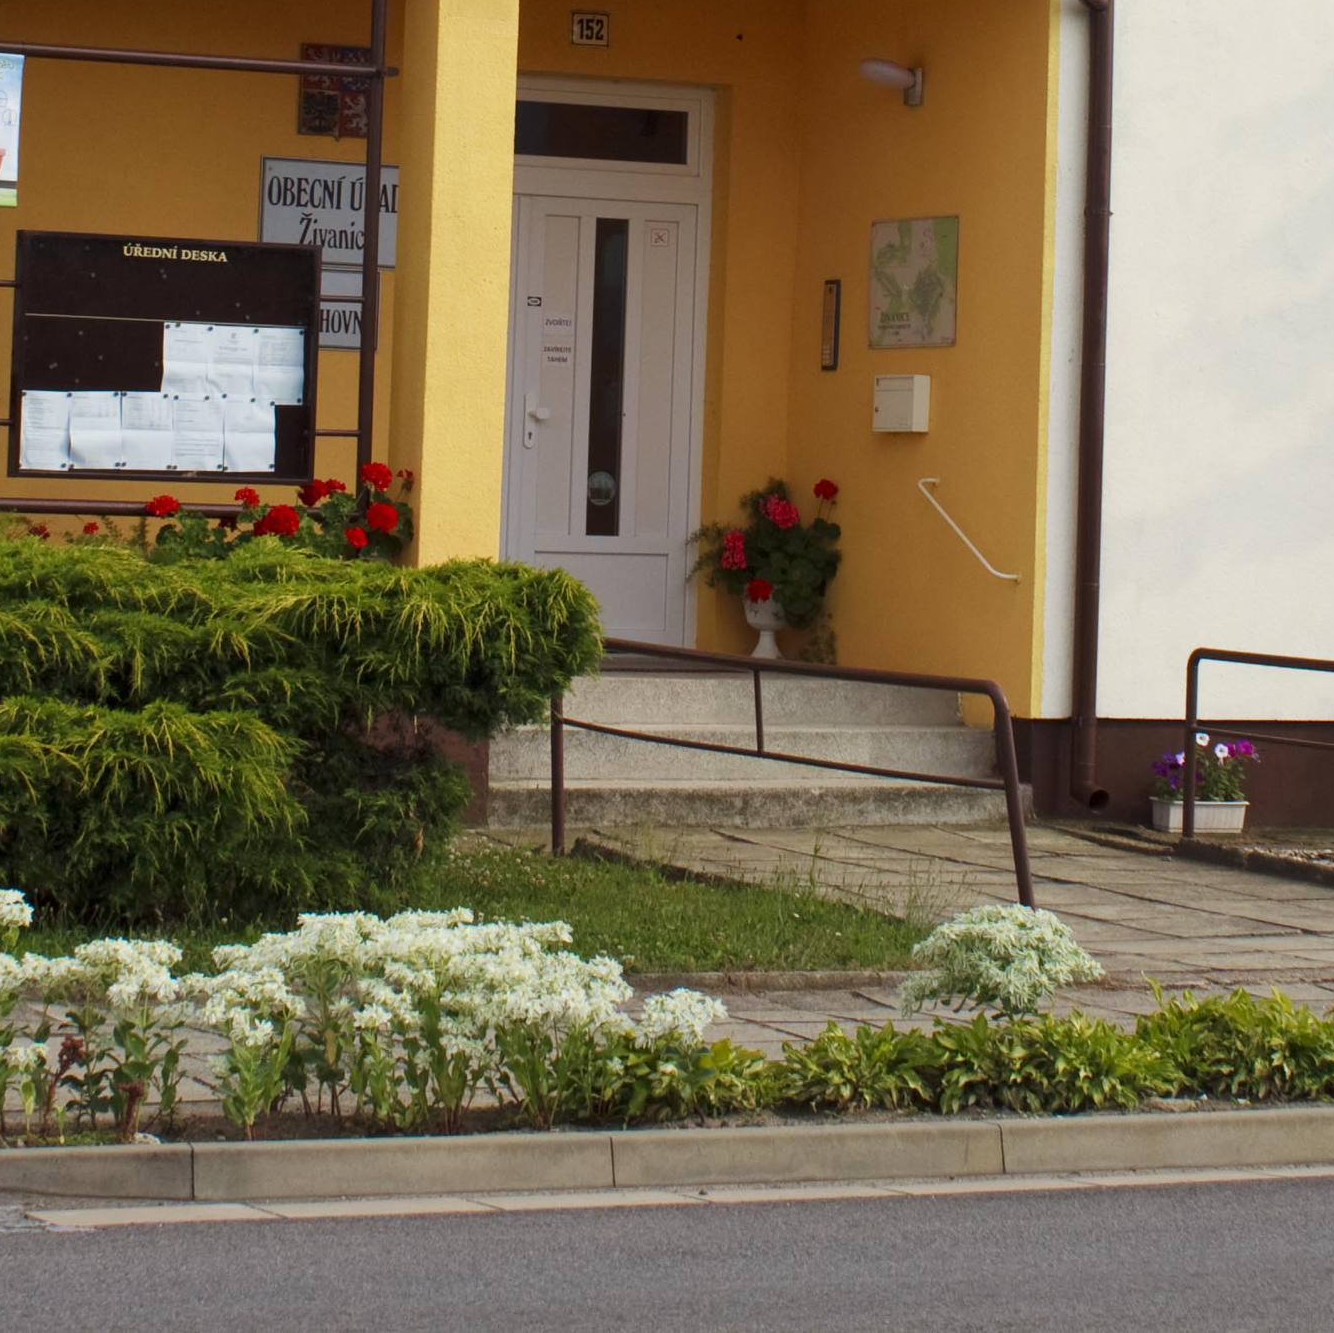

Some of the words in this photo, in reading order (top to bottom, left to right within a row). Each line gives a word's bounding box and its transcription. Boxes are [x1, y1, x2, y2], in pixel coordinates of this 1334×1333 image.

[577, 18, 604, 40] 152
[268, 175, 347, 210] OBECNÍ
[299, 212, 364, 251] Živanic
[123, 242, 178, 259] ÚŘEDNÍ
[181, 249, 228, 262] DESKA
